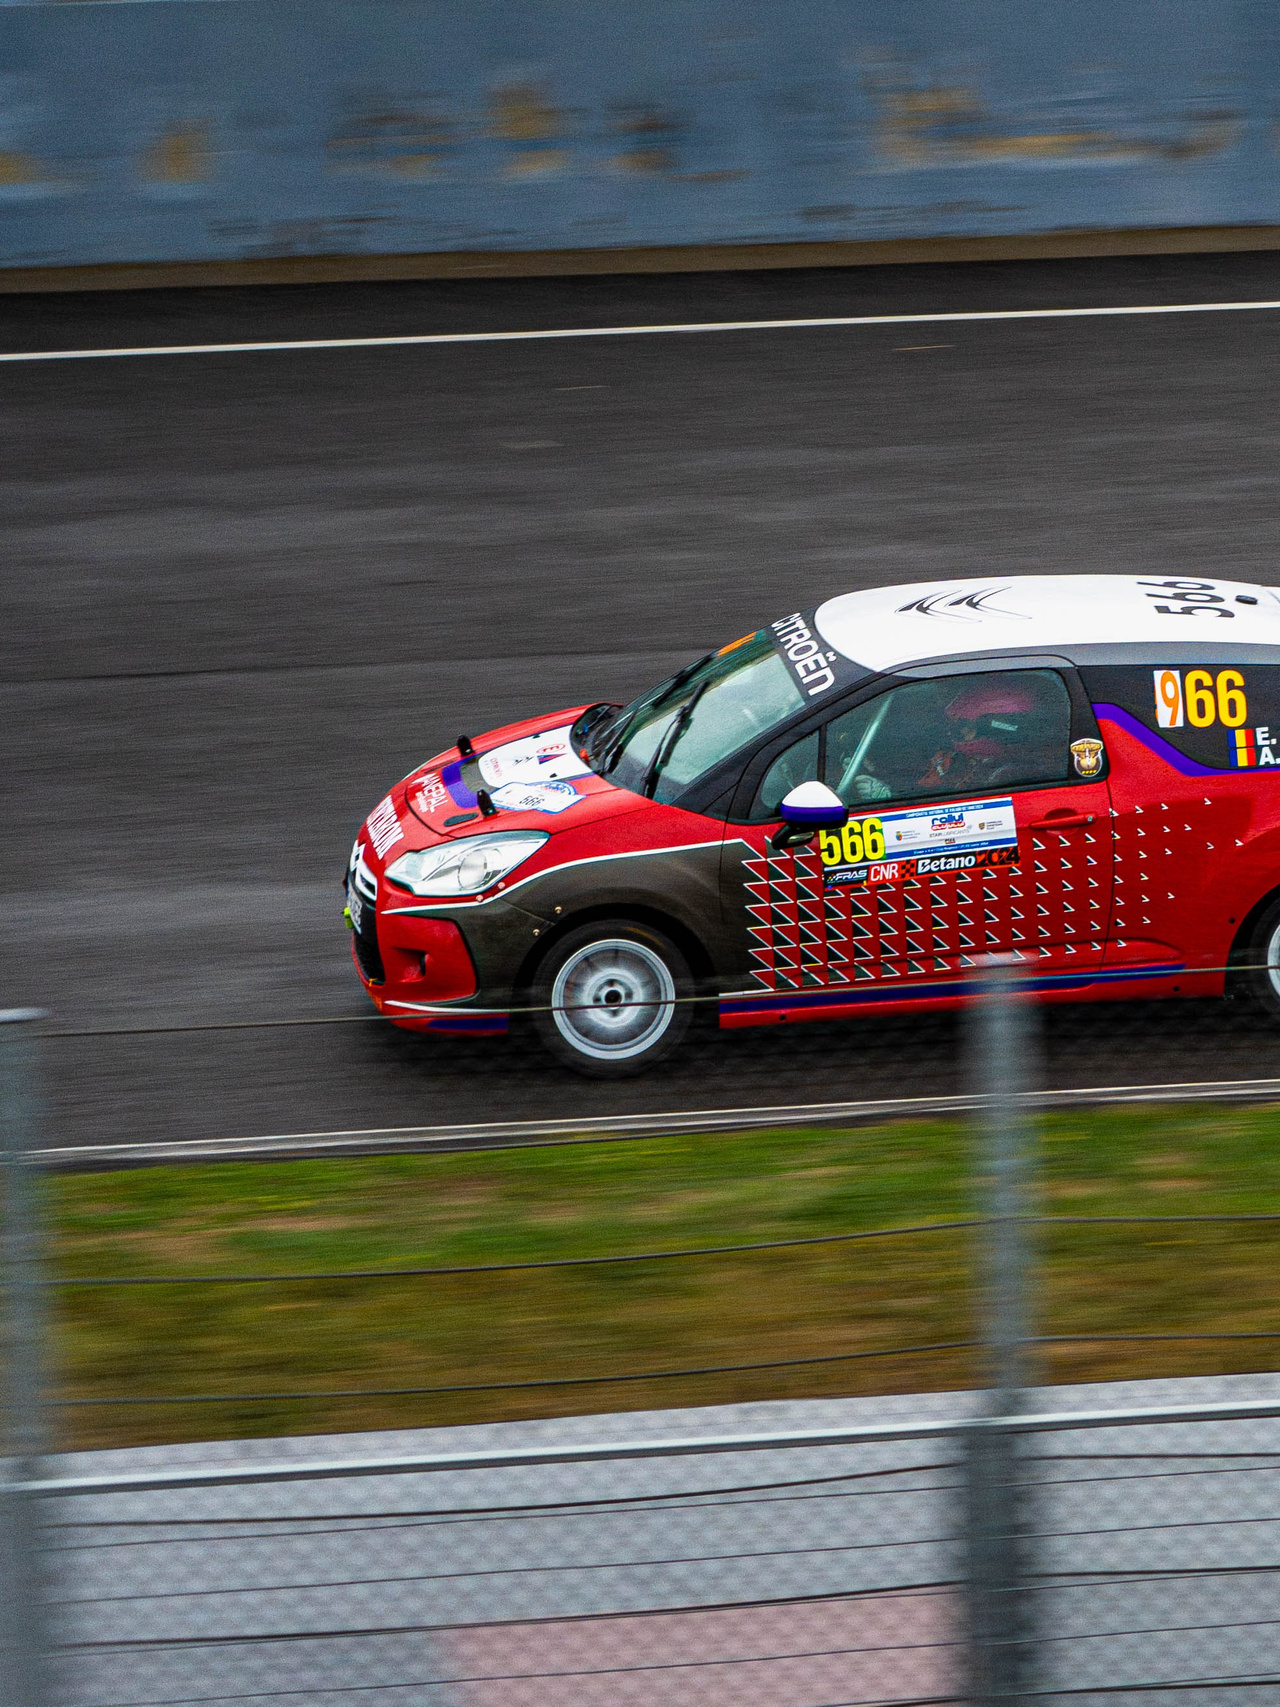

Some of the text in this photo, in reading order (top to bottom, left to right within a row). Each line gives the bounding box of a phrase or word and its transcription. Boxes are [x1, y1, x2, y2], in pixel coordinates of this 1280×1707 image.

[1136, 581, 1235, 618] 566
[771, 612, 837, 696] CITROËN
[1159, 669, 1248, 728] 966
[1255, 726, 1277, 746] E.
[819, 818, 885, 865] 566
[835, 869, 868, 881] FRAS
[870, 863, 899, 882] CNR
[917, 854, 976, 874] Betano
